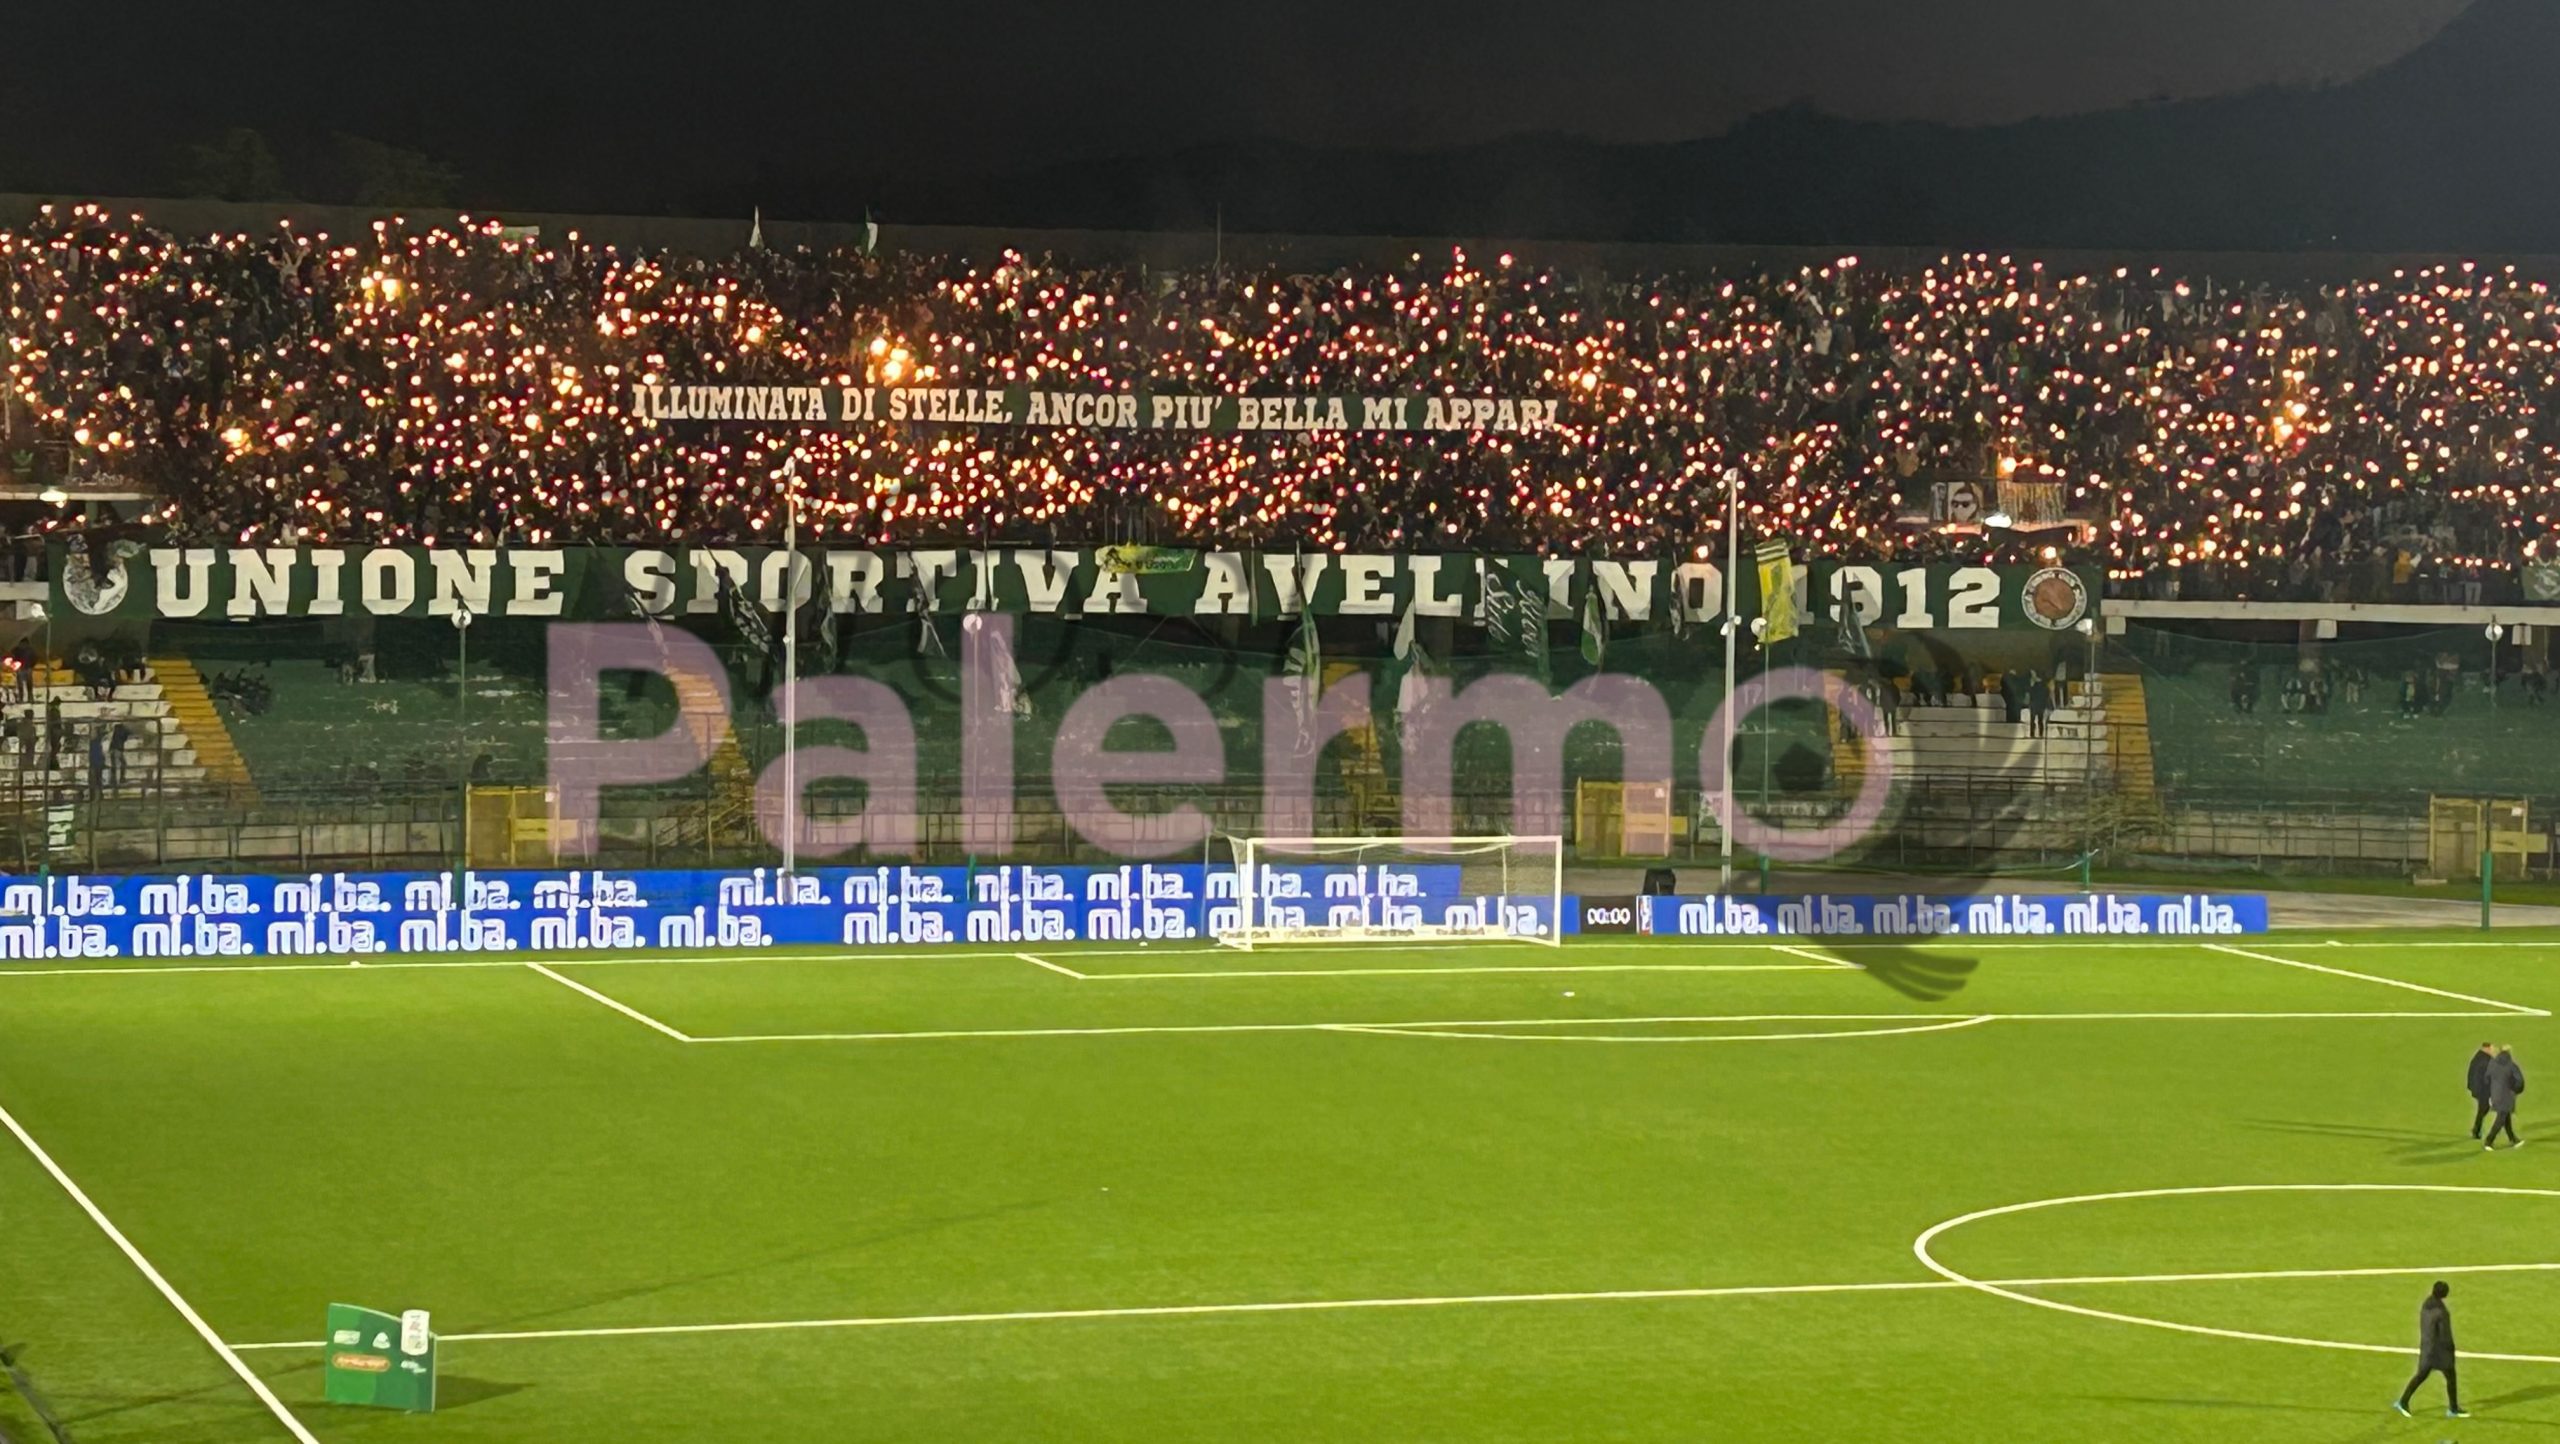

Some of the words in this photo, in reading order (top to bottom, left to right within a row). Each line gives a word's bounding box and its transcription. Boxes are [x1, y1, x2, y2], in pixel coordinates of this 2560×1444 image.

[632, 384, 827, 421] ILLUMINATA
[841, 387, 875, 422] DI
[889, 388, 1013, 425] STELLE,
[1026, 391, 1137, 428] ANCOR
[1151, 394, 1222, 429] PIU'
[1237, 396, 1348, 430] BELLA
[1363, 397, 1406, 430] MI
[149, 548, 565, 619] UNIONE
[624, 548, 1148, 620] SPORTIVA
[140, 874, 260, 916] mi.ba.
[274, 872, 392, 914] mi.ba.
[405, 871, 521, 911] mi.ba.
[1587, 907, 1631, 925] 00:00
[1679, 894, 1768, 935] mi.ba.
[1778, 894, 1863, 935] mi.ba.
[1873, 894, 1960, 935] mi.ba.
[1968, 894, 2055, 935] mi.ba.
[2064, 894, 2149, 935] mi.ba.
[2158, 894, 2243, 935] mi.ba.
[133, 914, 253, 956] mi.ba.
[267, 912, 387, 955] mi.ba.
[400, 909, 518, 952] mi.ba.
[531, 906, 646, 949] mi.ba.
[660, 904, 773, 947] mi.ba.
[843, 902, 954, 945] mi.ba.
[966, 899, 1076, 942] mi.ba.
[1088, 900, 1196, 940] mi.ba.
